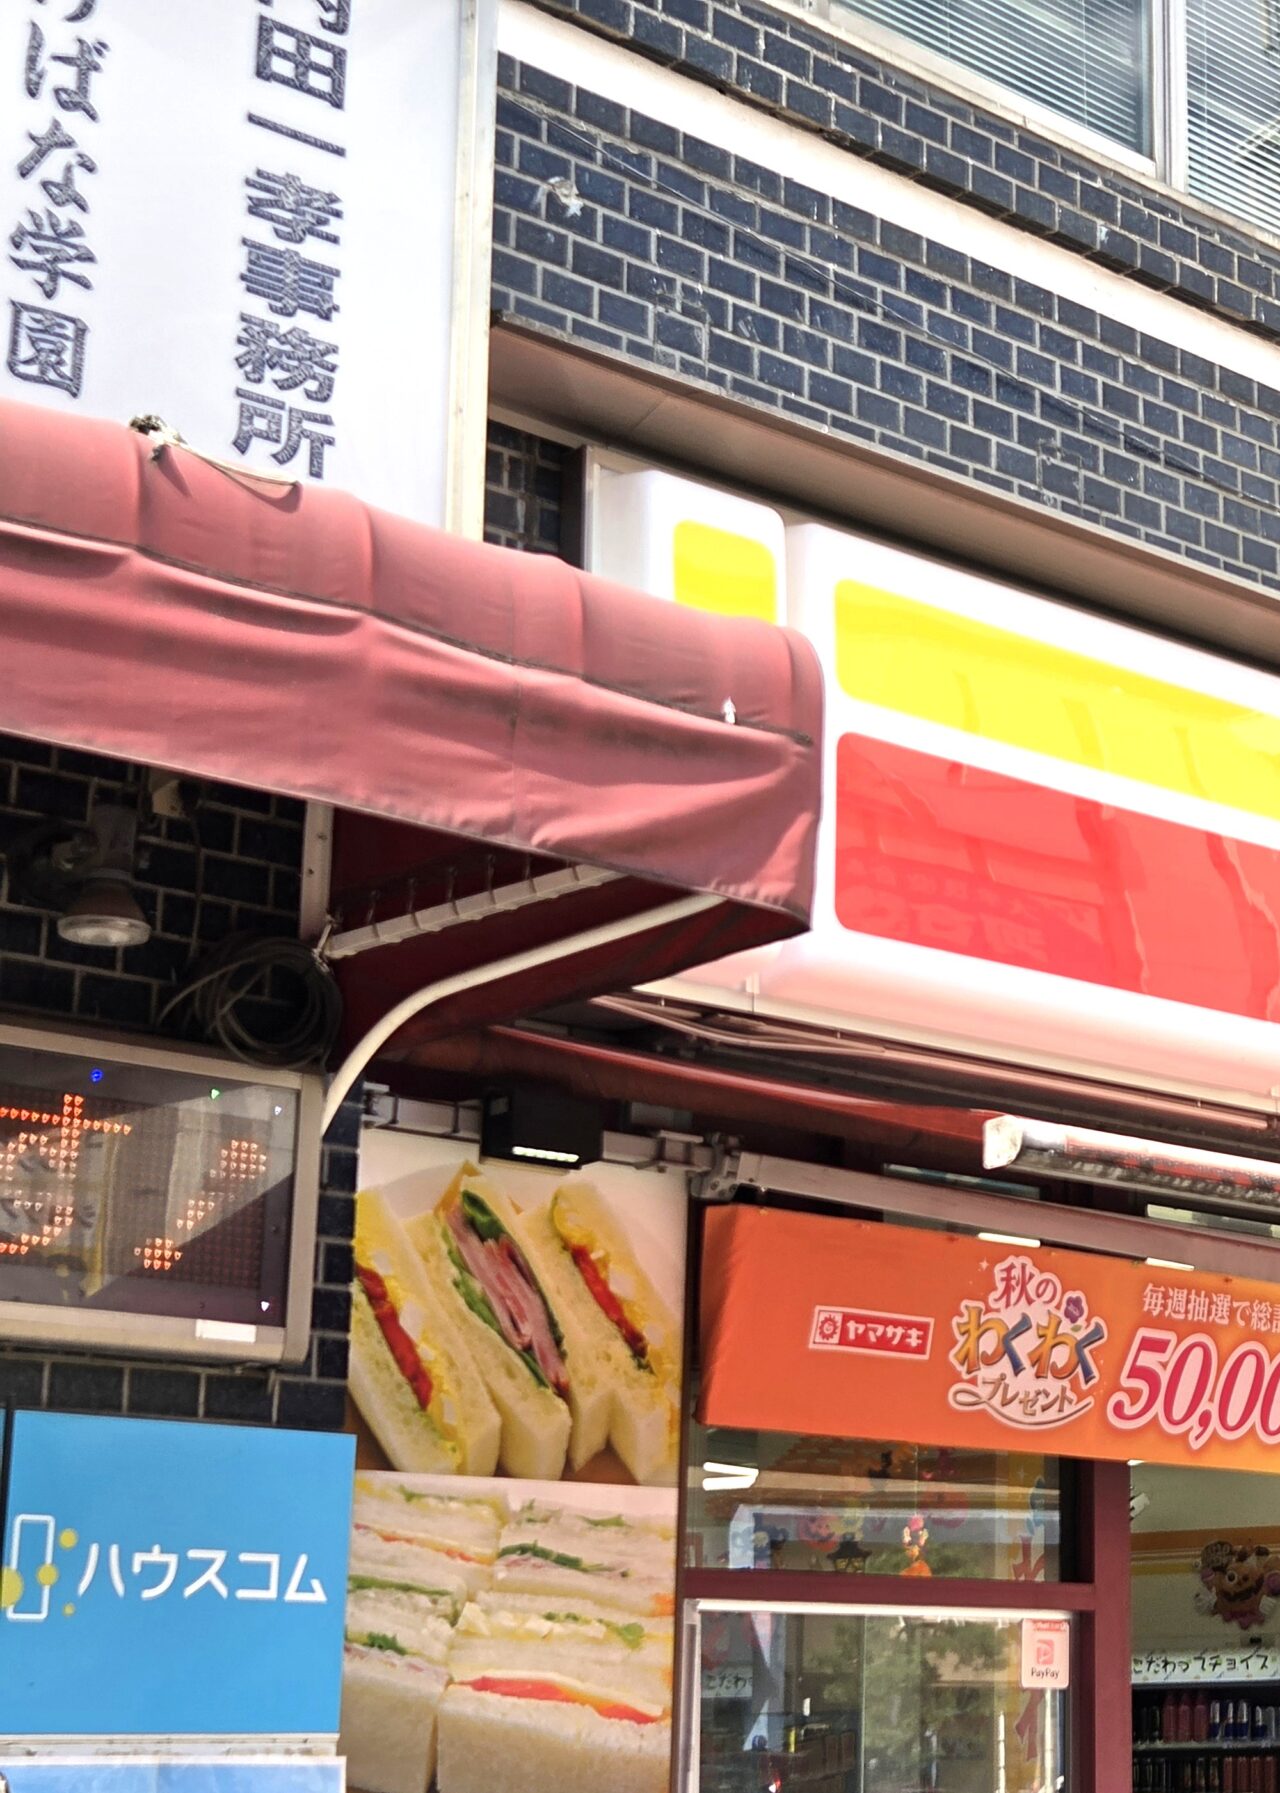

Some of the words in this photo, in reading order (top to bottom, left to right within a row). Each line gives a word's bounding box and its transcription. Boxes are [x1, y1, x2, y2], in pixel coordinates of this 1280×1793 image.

[5, 0, 111, 399] ばな学園
[994, 1261, 1059, 1309] 秋の
[845, 1319, 926, 1349] ヤマザキ
[953, 1304, 1105, 1385] わくわく
[982, 1376, 1075, 1417] プレゼント
[76, 1541, 328, 1604] ハウスコム
[1031, 1667, 1060, 1679] PayPay
